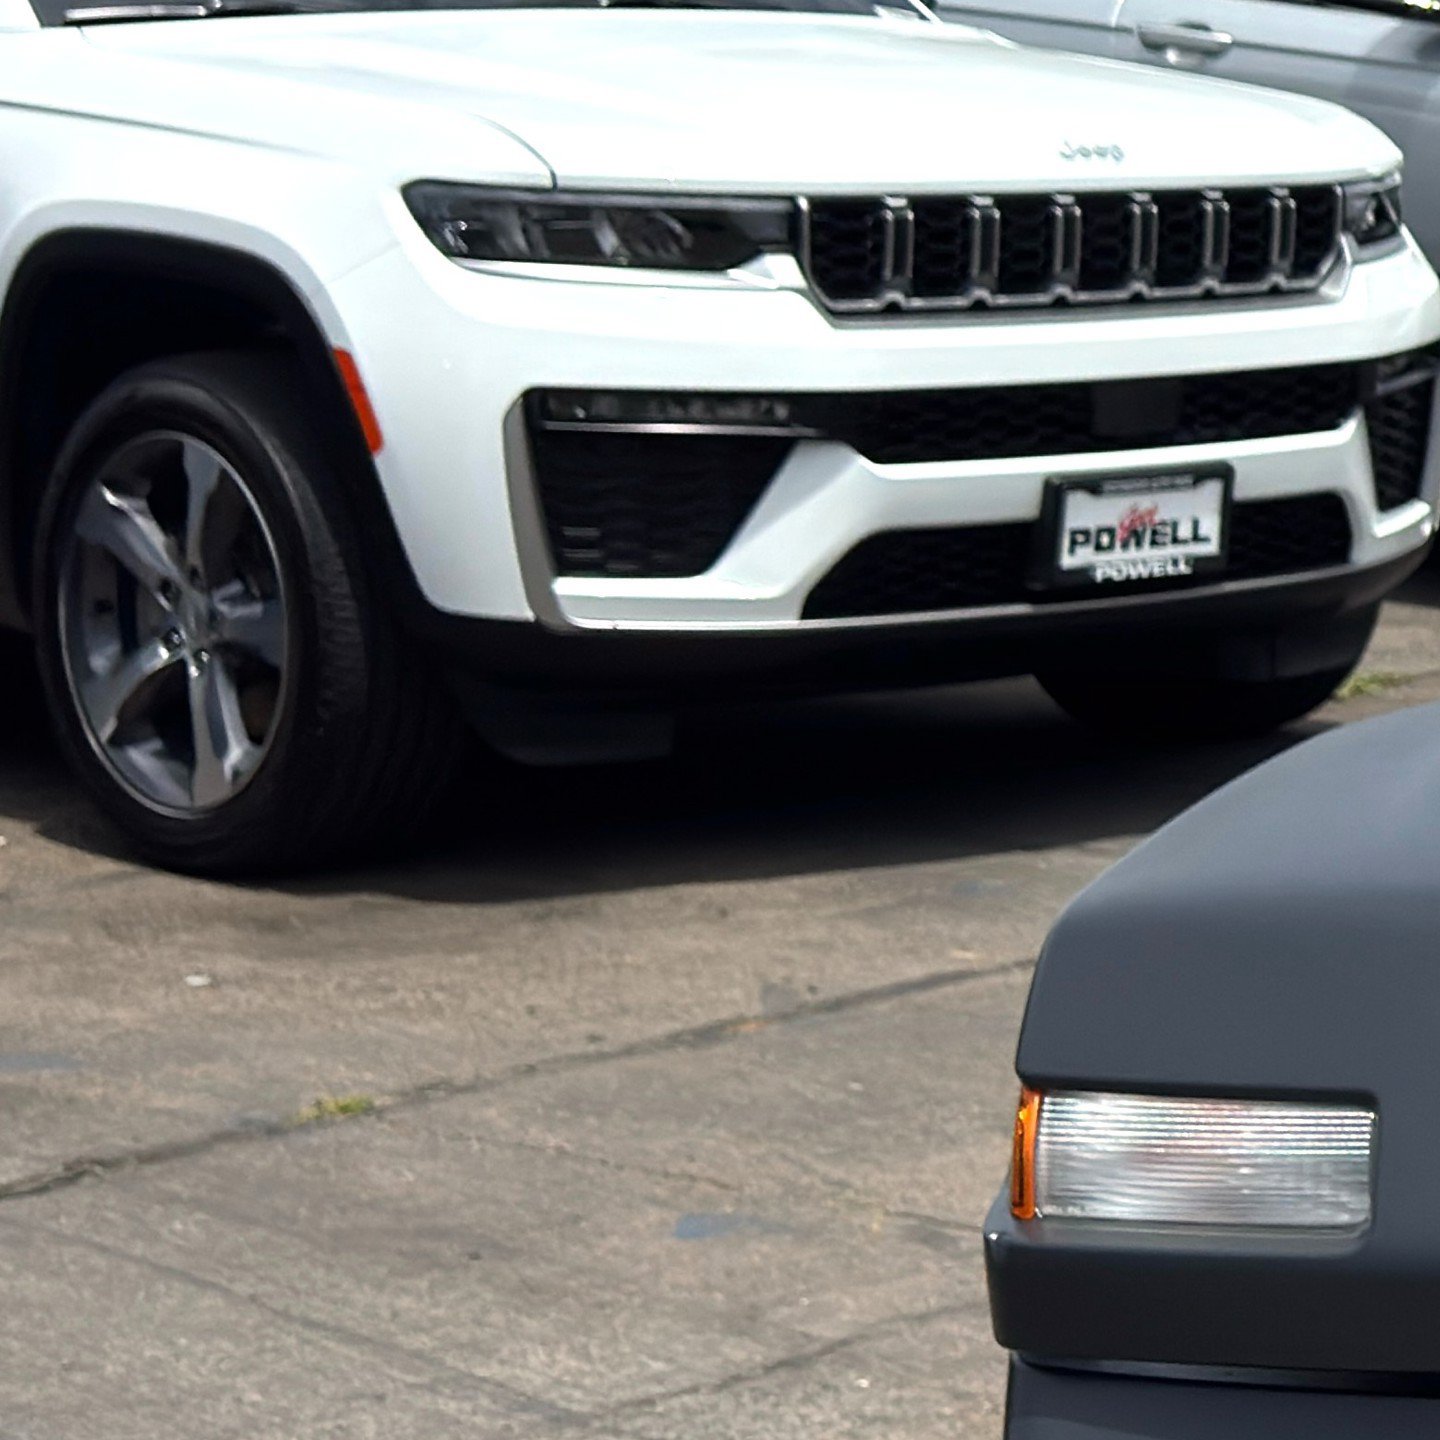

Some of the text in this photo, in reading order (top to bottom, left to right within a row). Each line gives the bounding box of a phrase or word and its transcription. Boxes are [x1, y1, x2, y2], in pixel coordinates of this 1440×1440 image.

[1059, 140, 1124, 163] Jeep
[1068, 516, 1211, 556] POWELL
[1094, 556, 1194, 583] POWELL
